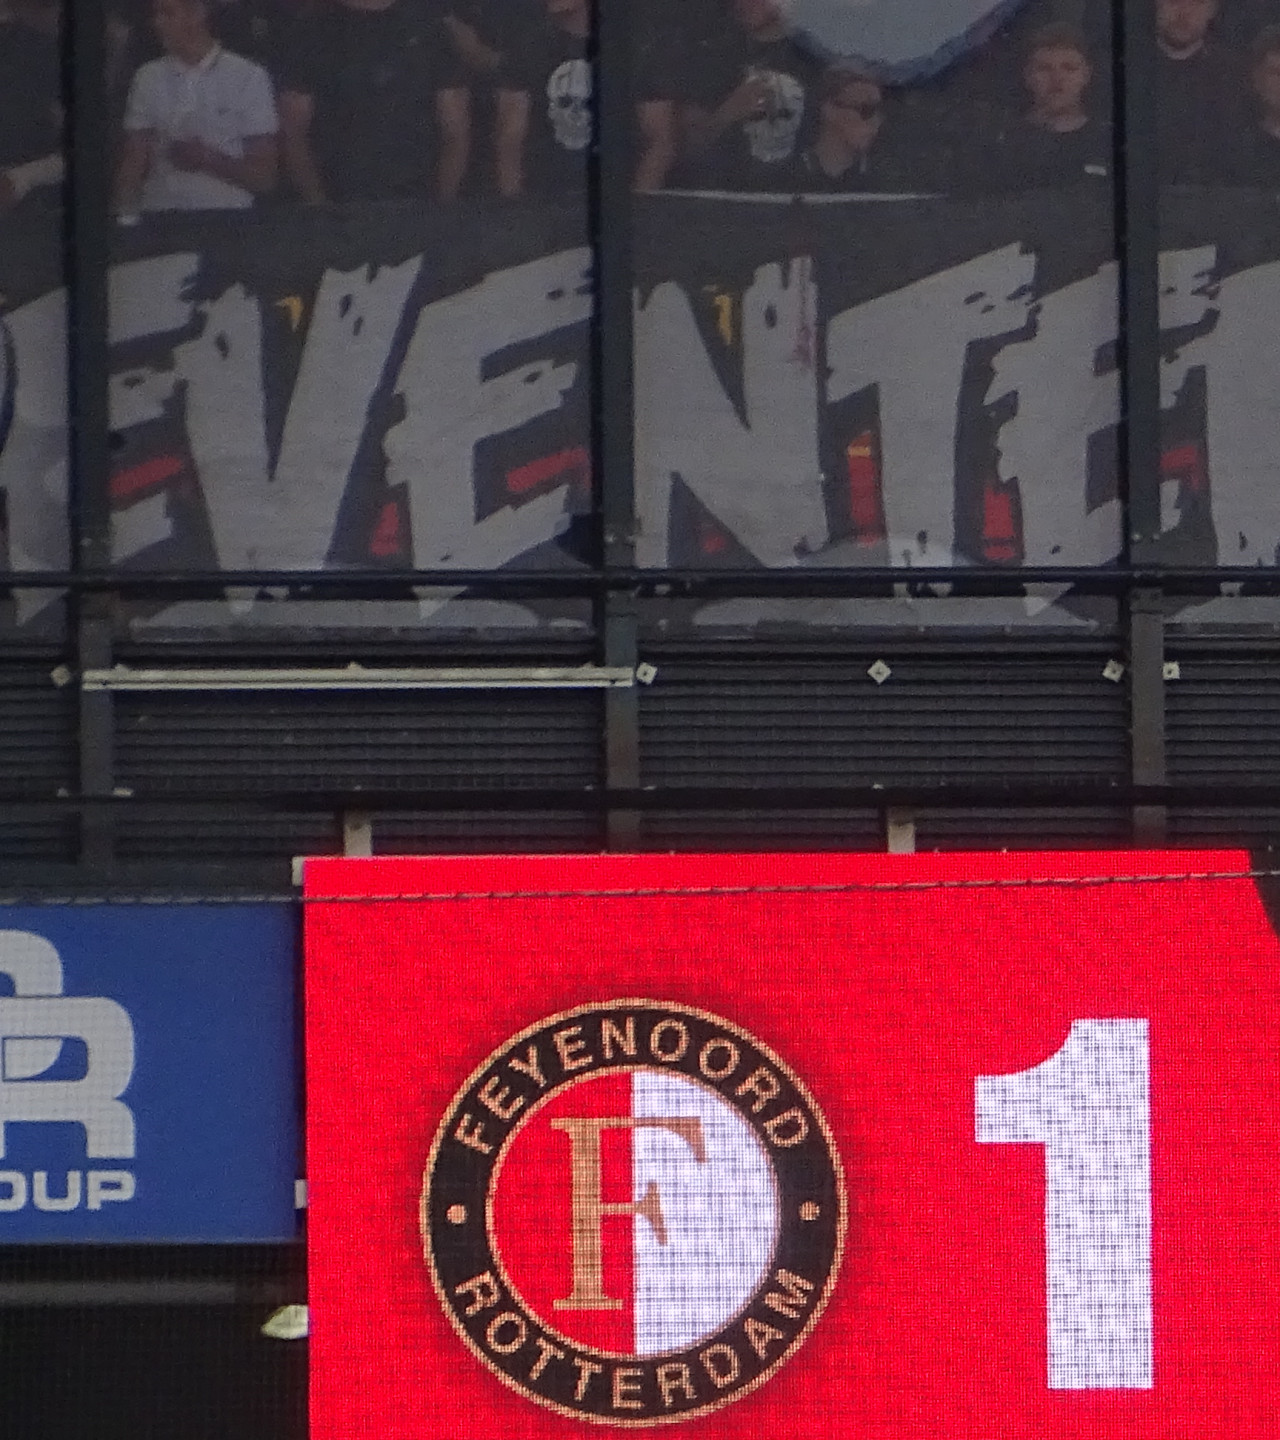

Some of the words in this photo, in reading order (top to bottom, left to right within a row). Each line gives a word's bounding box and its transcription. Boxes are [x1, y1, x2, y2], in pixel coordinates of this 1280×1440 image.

[456, 1018, 812, 1156] FEYENOORD
[974, 1017, 1155, 1391] 1
[455, 1268, 817, 1411] ROTTERDAM
